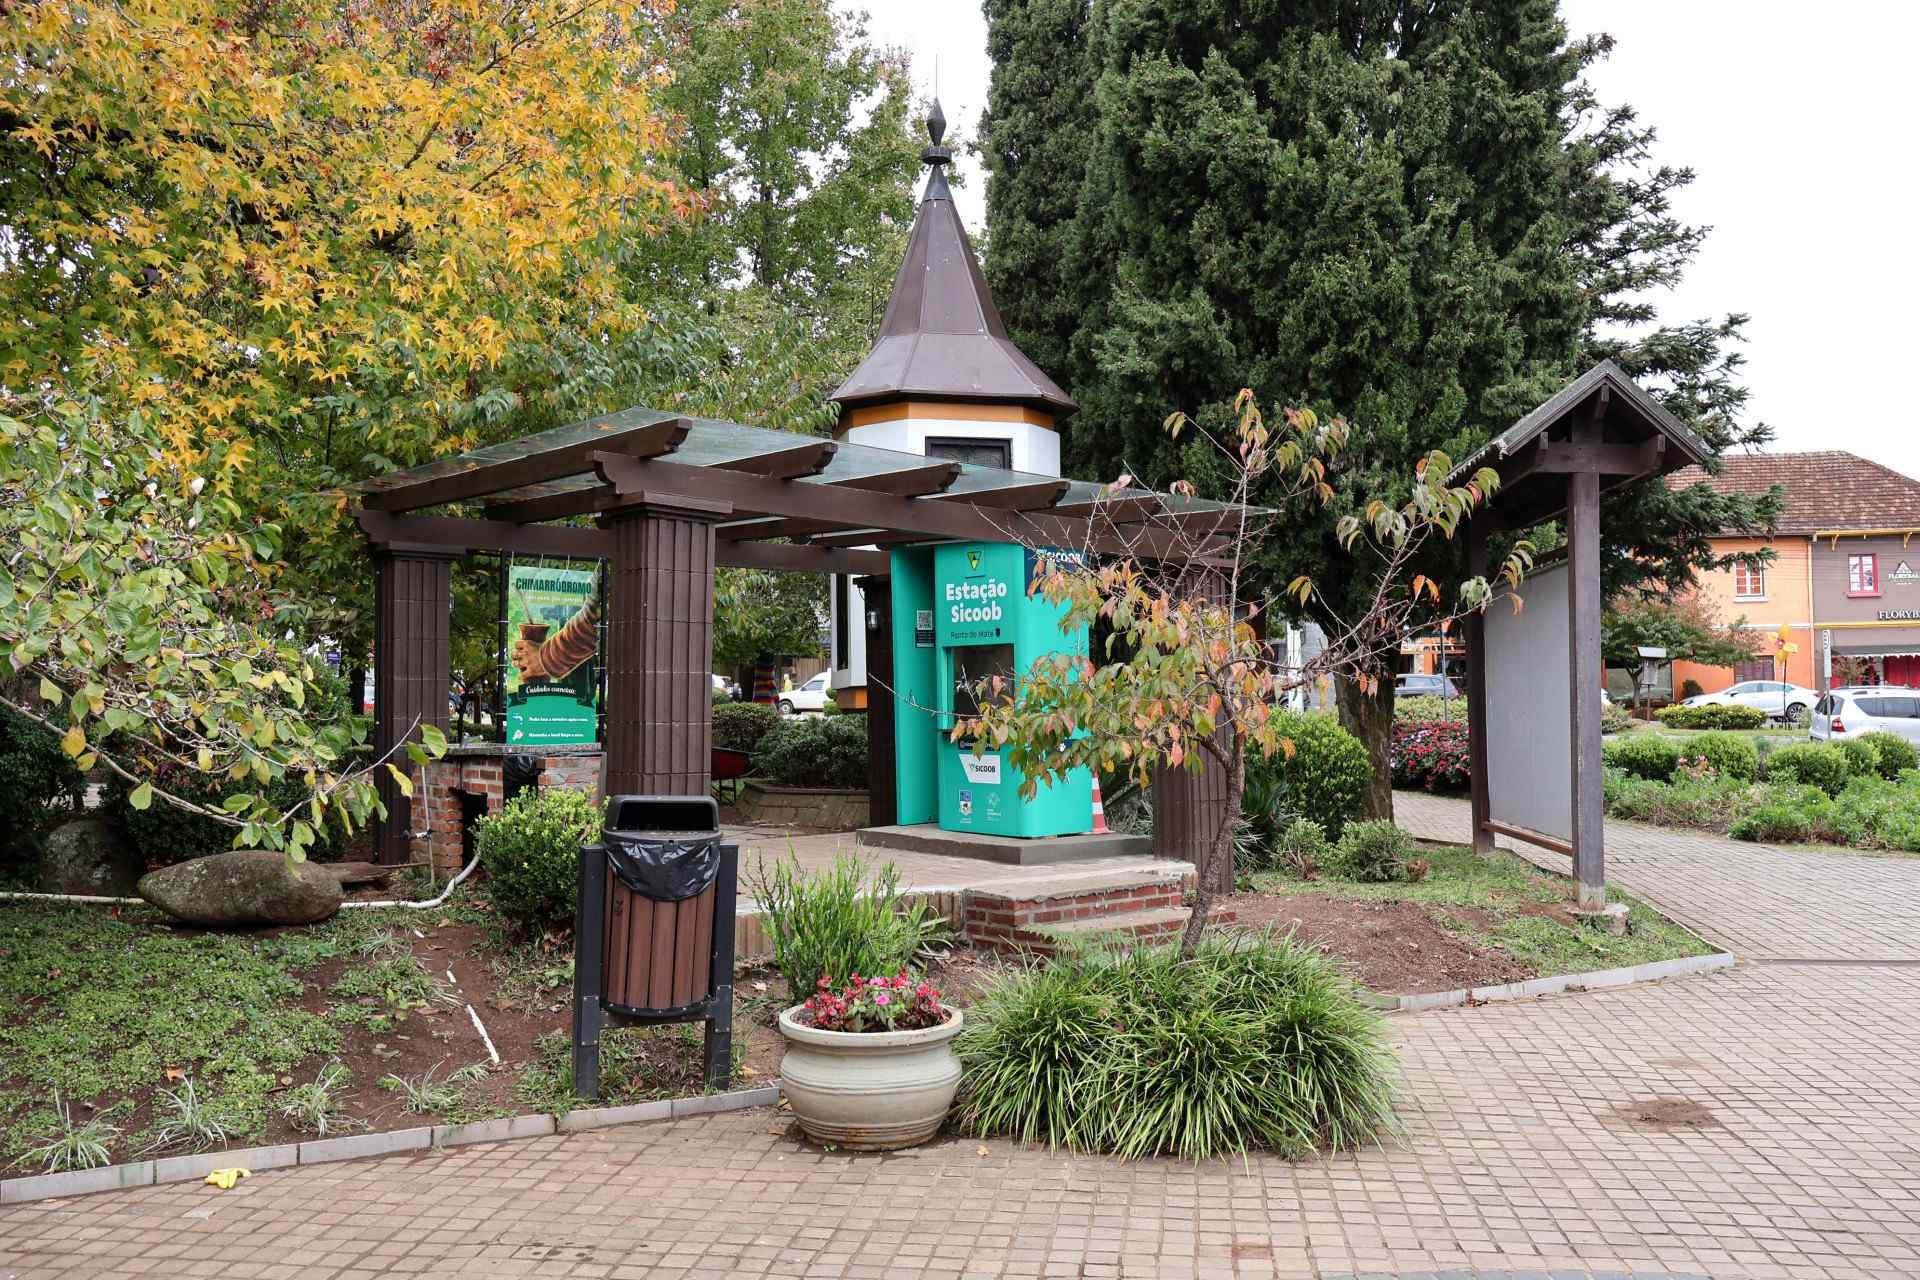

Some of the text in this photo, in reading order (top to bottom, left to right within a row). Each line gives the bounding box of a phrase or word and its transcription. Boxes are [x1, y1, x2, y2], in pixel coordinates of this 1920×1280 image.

[516, 577, 592, 594] CHIMARRÓDROMO
[946, 578, 1007, 603] Estação
[951, 601, 1002, 623] Sicoob
[975, 765, 996, 773] SICOOB
